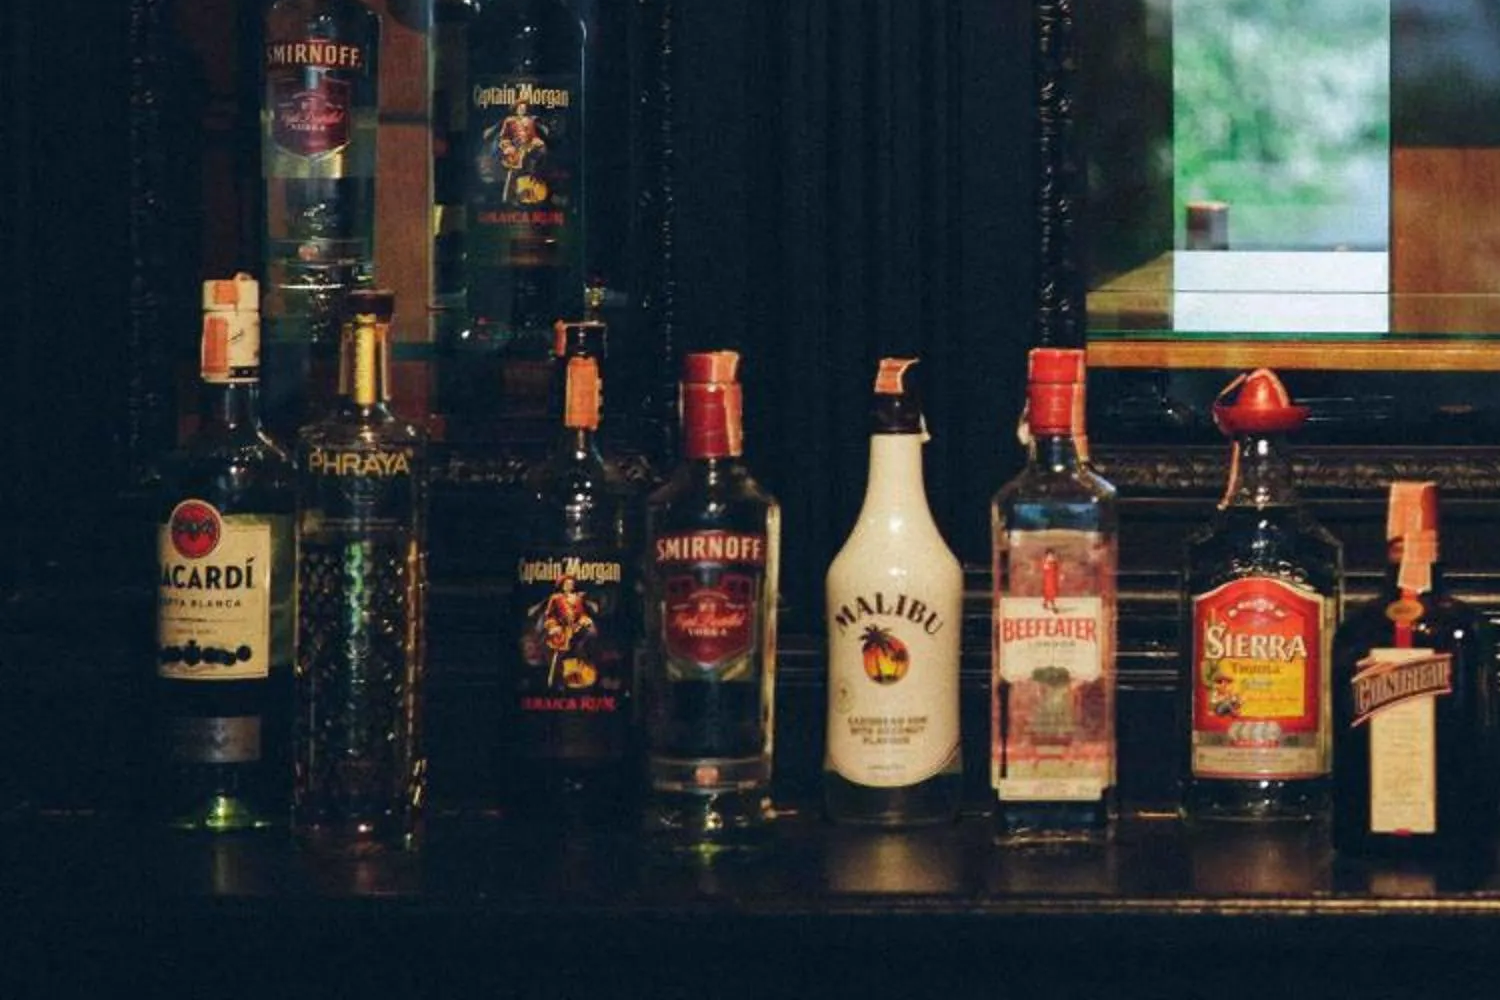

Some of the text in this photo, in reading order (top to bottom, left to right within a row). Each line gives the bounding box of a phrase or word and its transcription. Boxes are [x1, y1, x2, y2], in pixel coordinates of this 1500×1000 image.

[474, 81, 570, 109] Captain Morgan
[309, 450, 410, 476] PHRAYA
[655, 534, 762, 561] SMIRNOFF
[161, 557, 255, 589] ACARDÍ
[562, 556, 621, 585] Morgan
[835, 592, 944, 636] MALIBU
[1003, 617, 1097, 643] BEEFEATER
[1205, 623, 1308, 662] SIERRA
